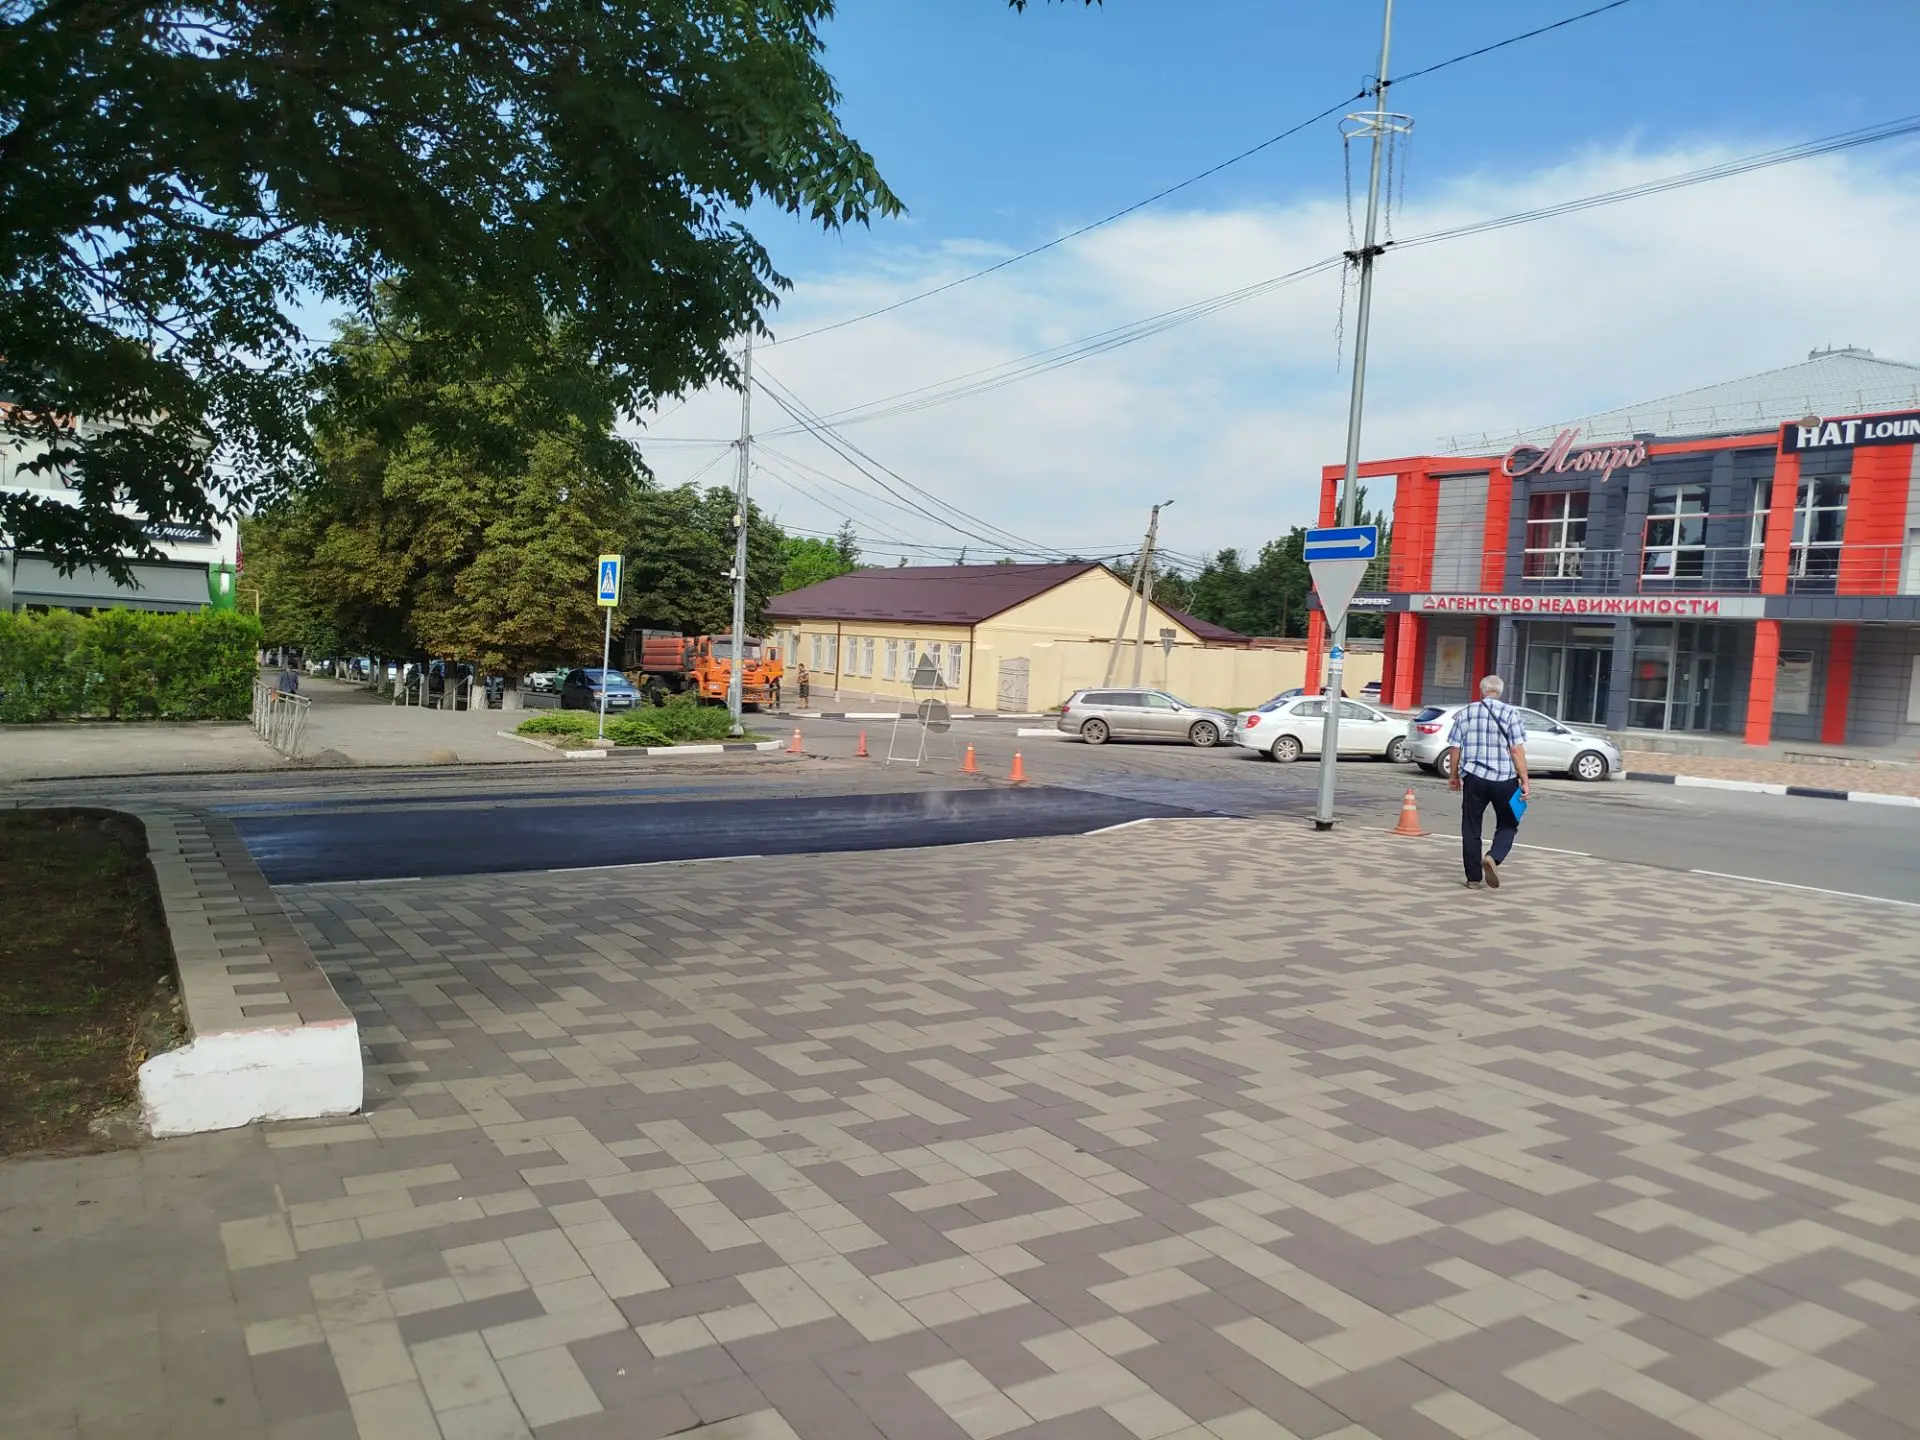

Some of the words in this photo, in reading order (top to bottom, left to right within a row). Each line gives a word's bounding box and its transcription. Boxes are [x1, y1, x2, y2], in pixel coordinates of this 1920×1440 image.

[1796, 420, 1863, 448] HAT
[1437, 594, 1533, 612] АГЕНТСТВО
[1538, 597, 1719, 616] НЕДВИЖИМОСТИ
